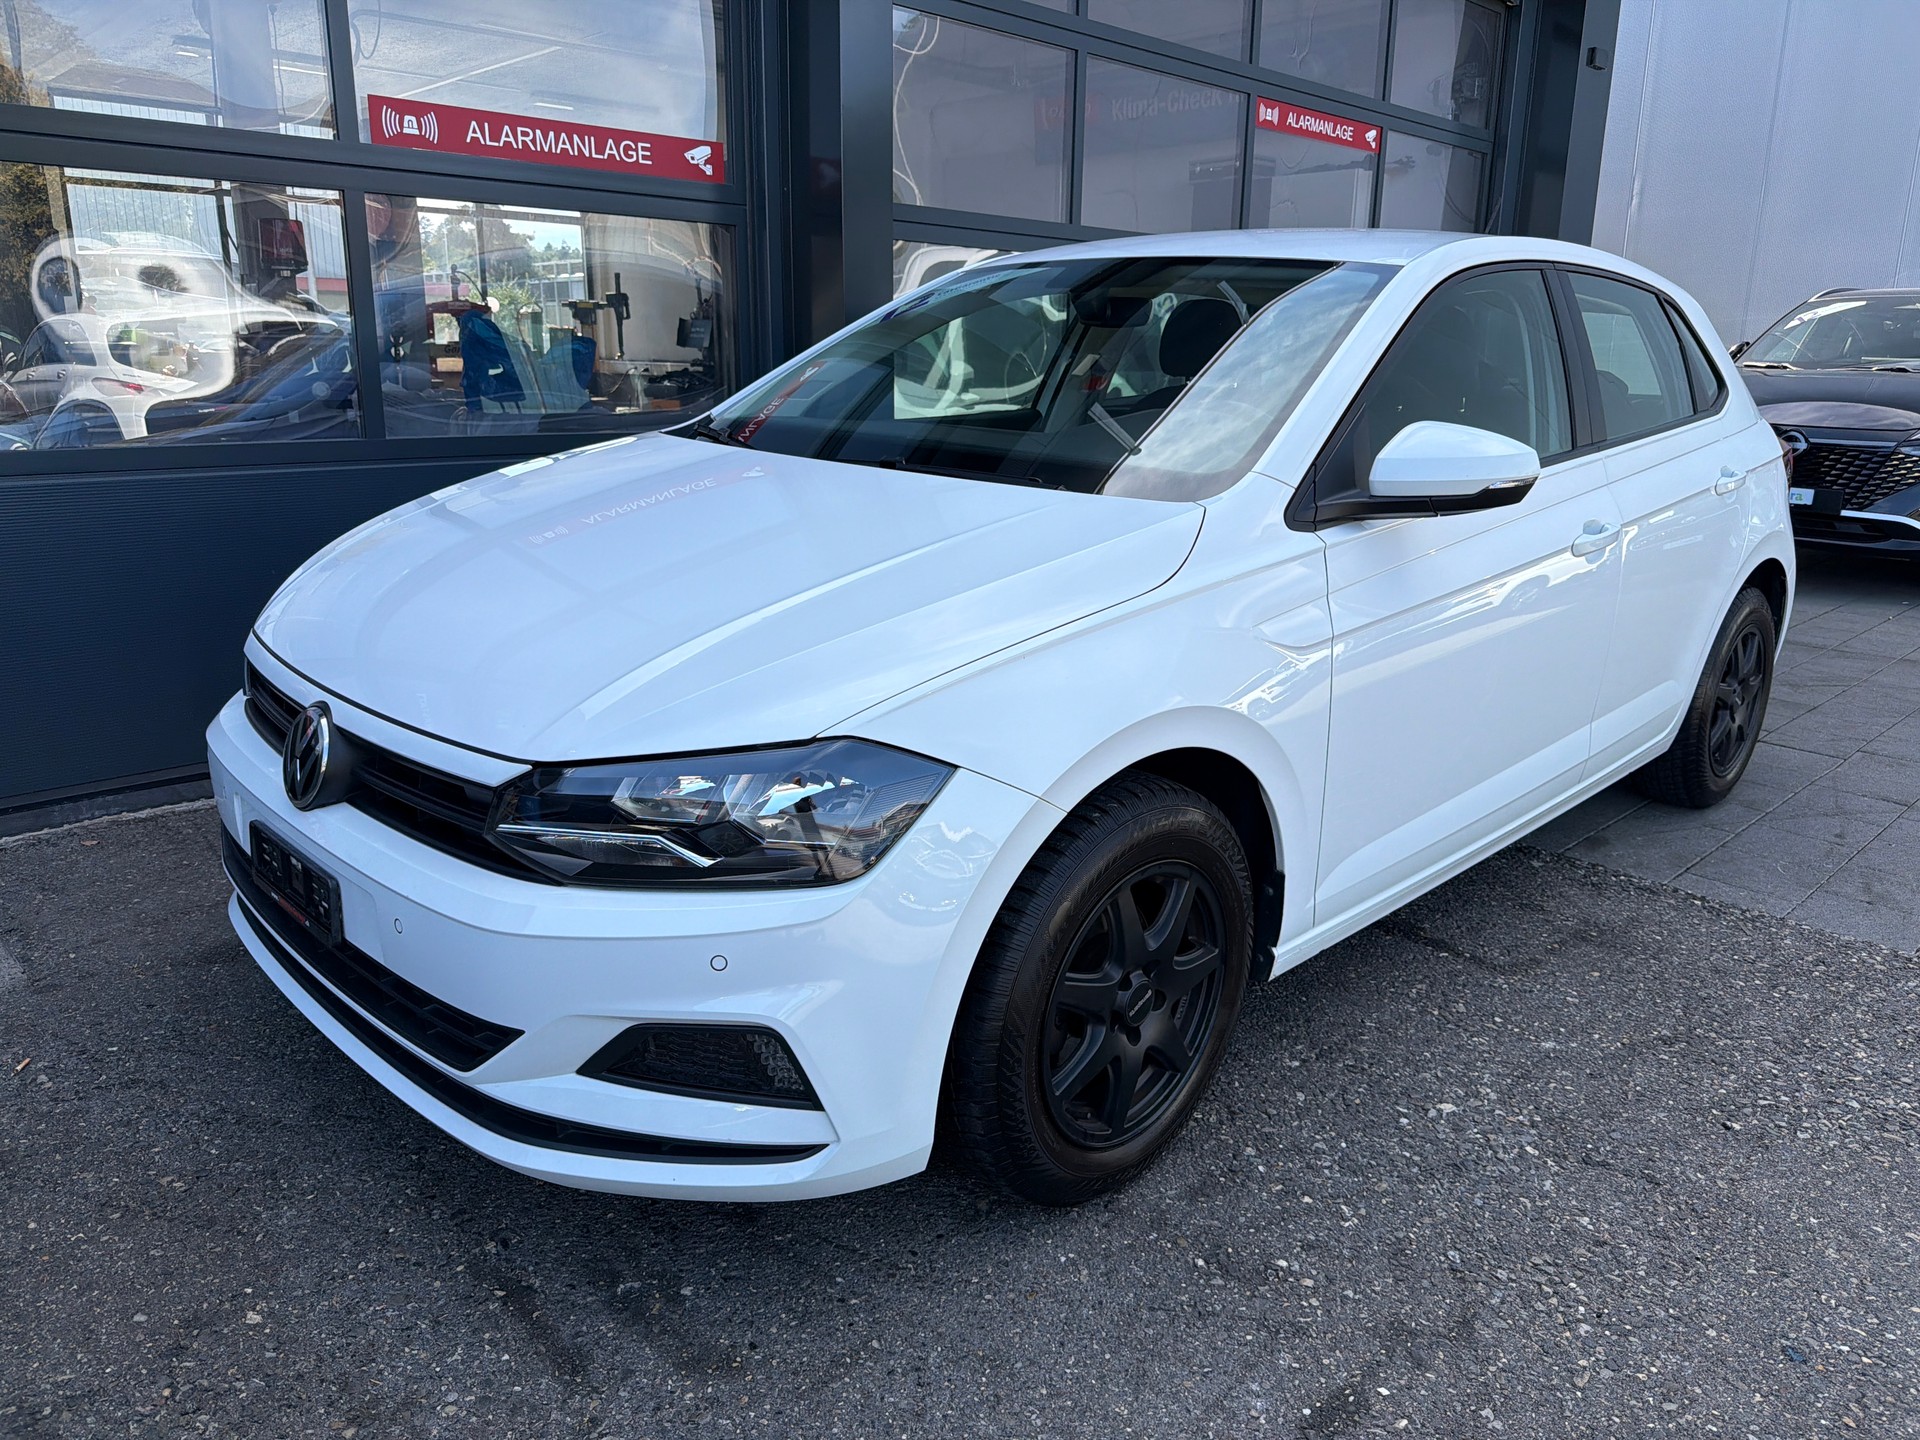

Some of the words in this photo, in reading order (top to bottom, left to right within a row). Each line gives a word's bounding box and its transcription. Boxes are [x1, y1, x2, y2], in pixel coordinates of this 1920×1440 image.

[1111, 88, 1223, 121] Klima-Check
[466, 120, 652, 165] ALARMANLAGE
[1286, 111, 1354, 141] ALARMANLAGE
